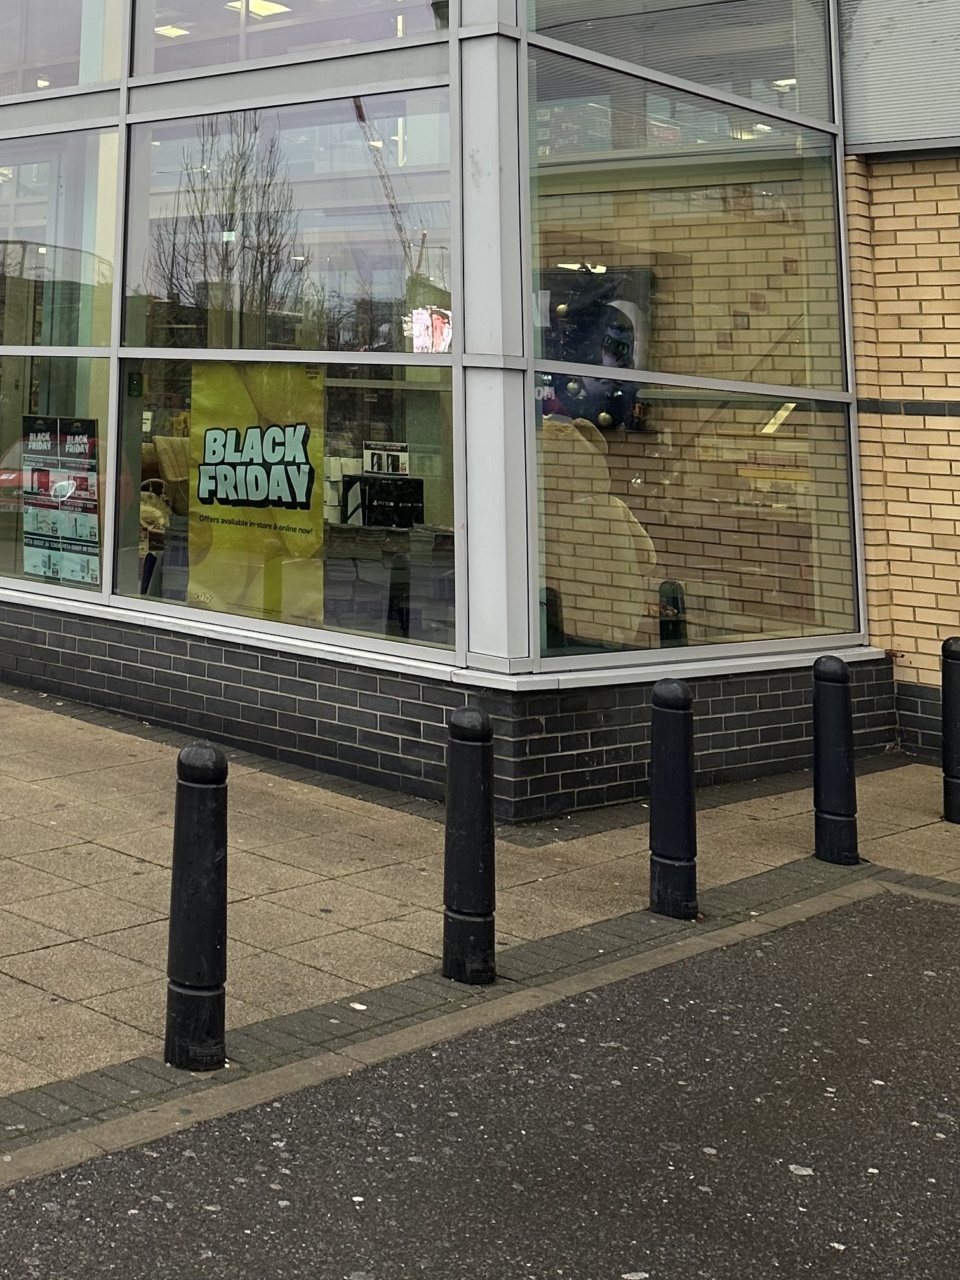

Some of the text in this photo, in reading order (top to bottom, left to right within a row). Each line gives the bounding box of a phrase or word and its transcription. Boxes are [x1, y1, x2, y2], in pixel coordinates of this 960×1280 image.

[29, 432, 50, 442] BLACK
[66, 435, 88, 444] BLACK
[28, 441, 52, 451] FRIDAY
[65, 444, 89, 453] FRIDAY
[204, 424, 308, 464] BLACK
[198, 464, 310, 502] FRIDAY
[198, 514, 220, 524] Offers
[220, 517, 248, 527] available
[249, 520, 272, 530] in-store
[279, 524, 300, 533] online
[298, 527, 313, 535] now!
